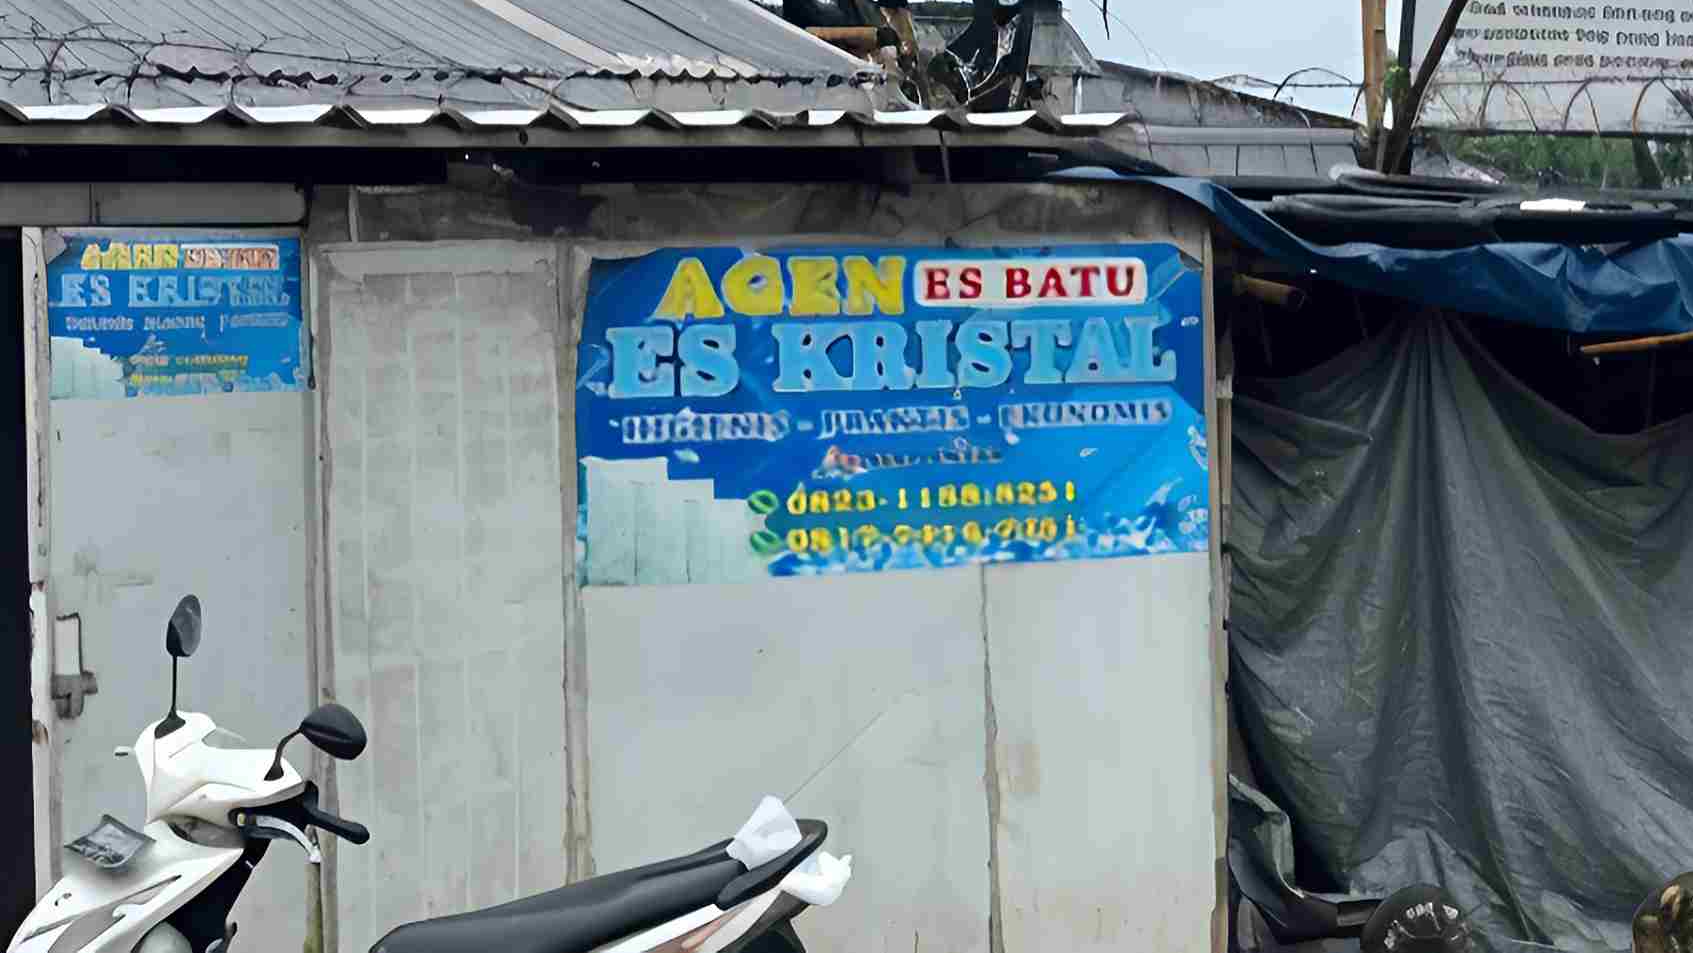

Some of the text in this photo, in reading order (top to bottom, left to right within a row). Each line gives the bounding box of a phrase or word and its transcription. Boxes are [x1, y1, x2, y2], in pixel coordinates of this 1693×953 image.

[653, 256, 1138, 319] AGEN ES BATU
[606, 315, 1177, 398] ES KRISTAL
